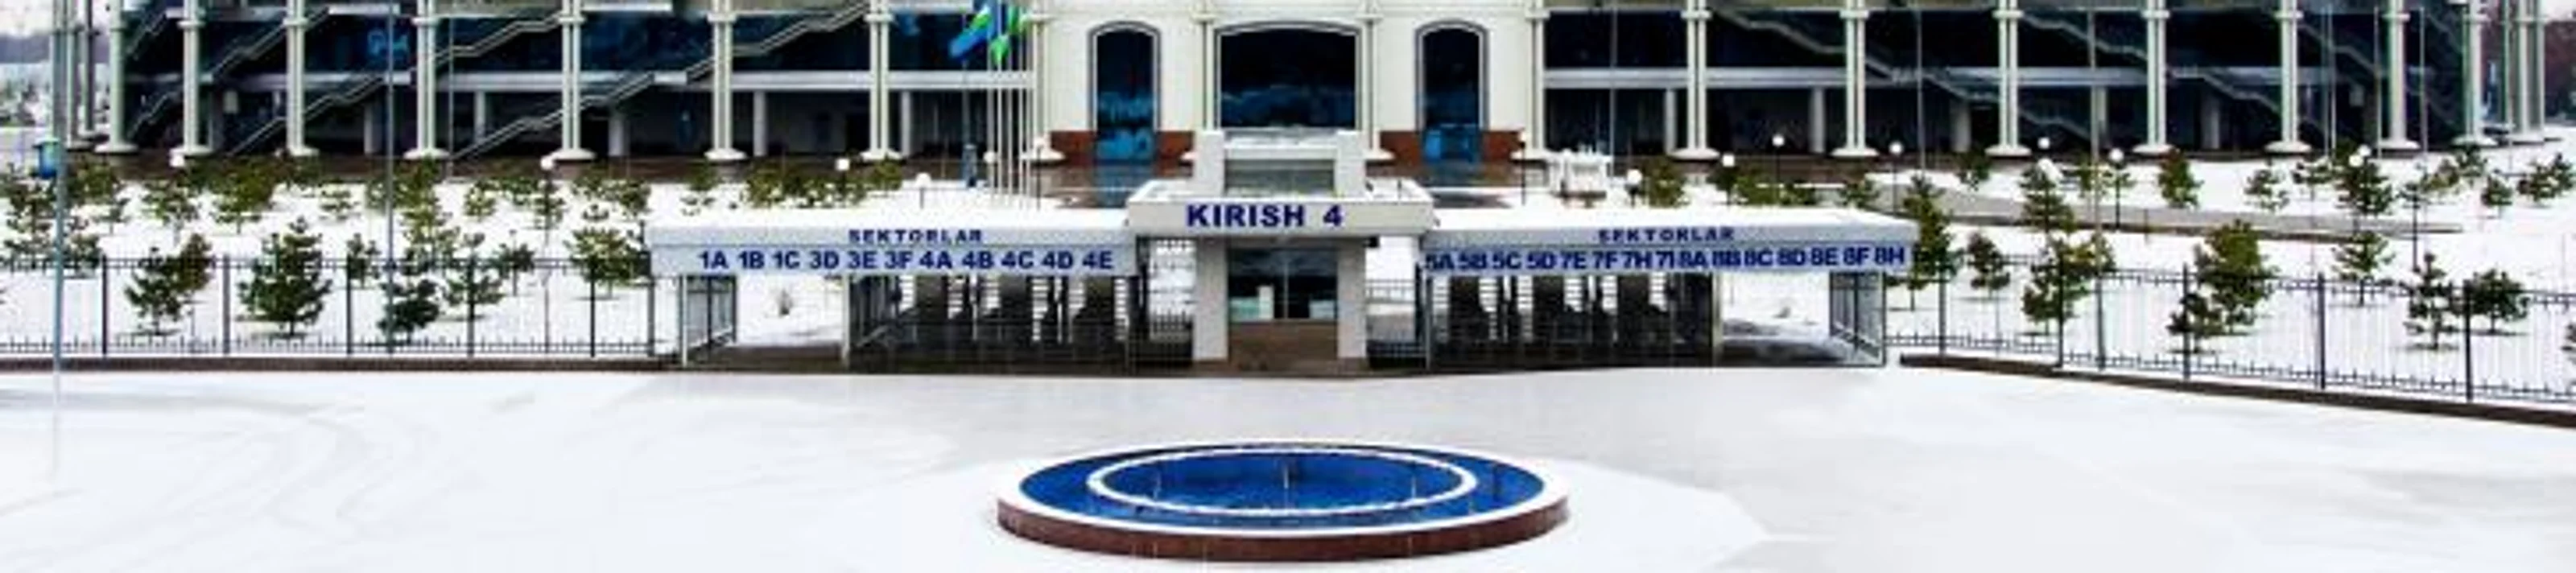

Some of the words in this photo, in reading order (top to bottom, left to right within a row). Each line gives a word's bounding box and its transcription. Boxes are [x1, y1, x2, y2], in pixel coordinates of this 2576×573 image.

[1187, 204, 1304, 228] KIRISH
[1323, 204, 1343, 227] 4
[848, 229, 981, 242] SEKTORLAR
[1598, 229, 1735, 241] SEKTORLAR
[699, 250, 729, 270] 1A
[737, 250, 765, 270] 1B
[771, 250, 800, 270] 1C
[809, 250, 840, 270] 3D
[848, 250, 877, 270] 3E
[884, 250, 913, 270] 3F
[919, 250, 953, 270] 4A
[962, 250, 994, 270] 4B
[1001, 250, 1034, 270] 4C
[1041, 250, 1074, 270] 4D
[1082, 250, 1113, 270] 4E
[1426, 251, 1455, 270] 5A
[1459, 251, 1488, 270] 5B
[1492, 251, 1521, 270] 5C
[1526, 251, 1557, 270] 5D
[1561, 251, 1587, 270] 7E
[1593, 251, 1618, 269] 7F
[1622, 250, 1653, 269] 7H
[1680, 250, 1710, 268] 8A
[1712, 250, 1741, 267] 8B
[1744, 249, 1773, 266] 8C
[1777, 249, 1807, 266] 8D
[1811, 248, 1839, 266] 8E
[1843, 247, 1871, 266] 8F
[1874, 247, 1905, 266] 8H
